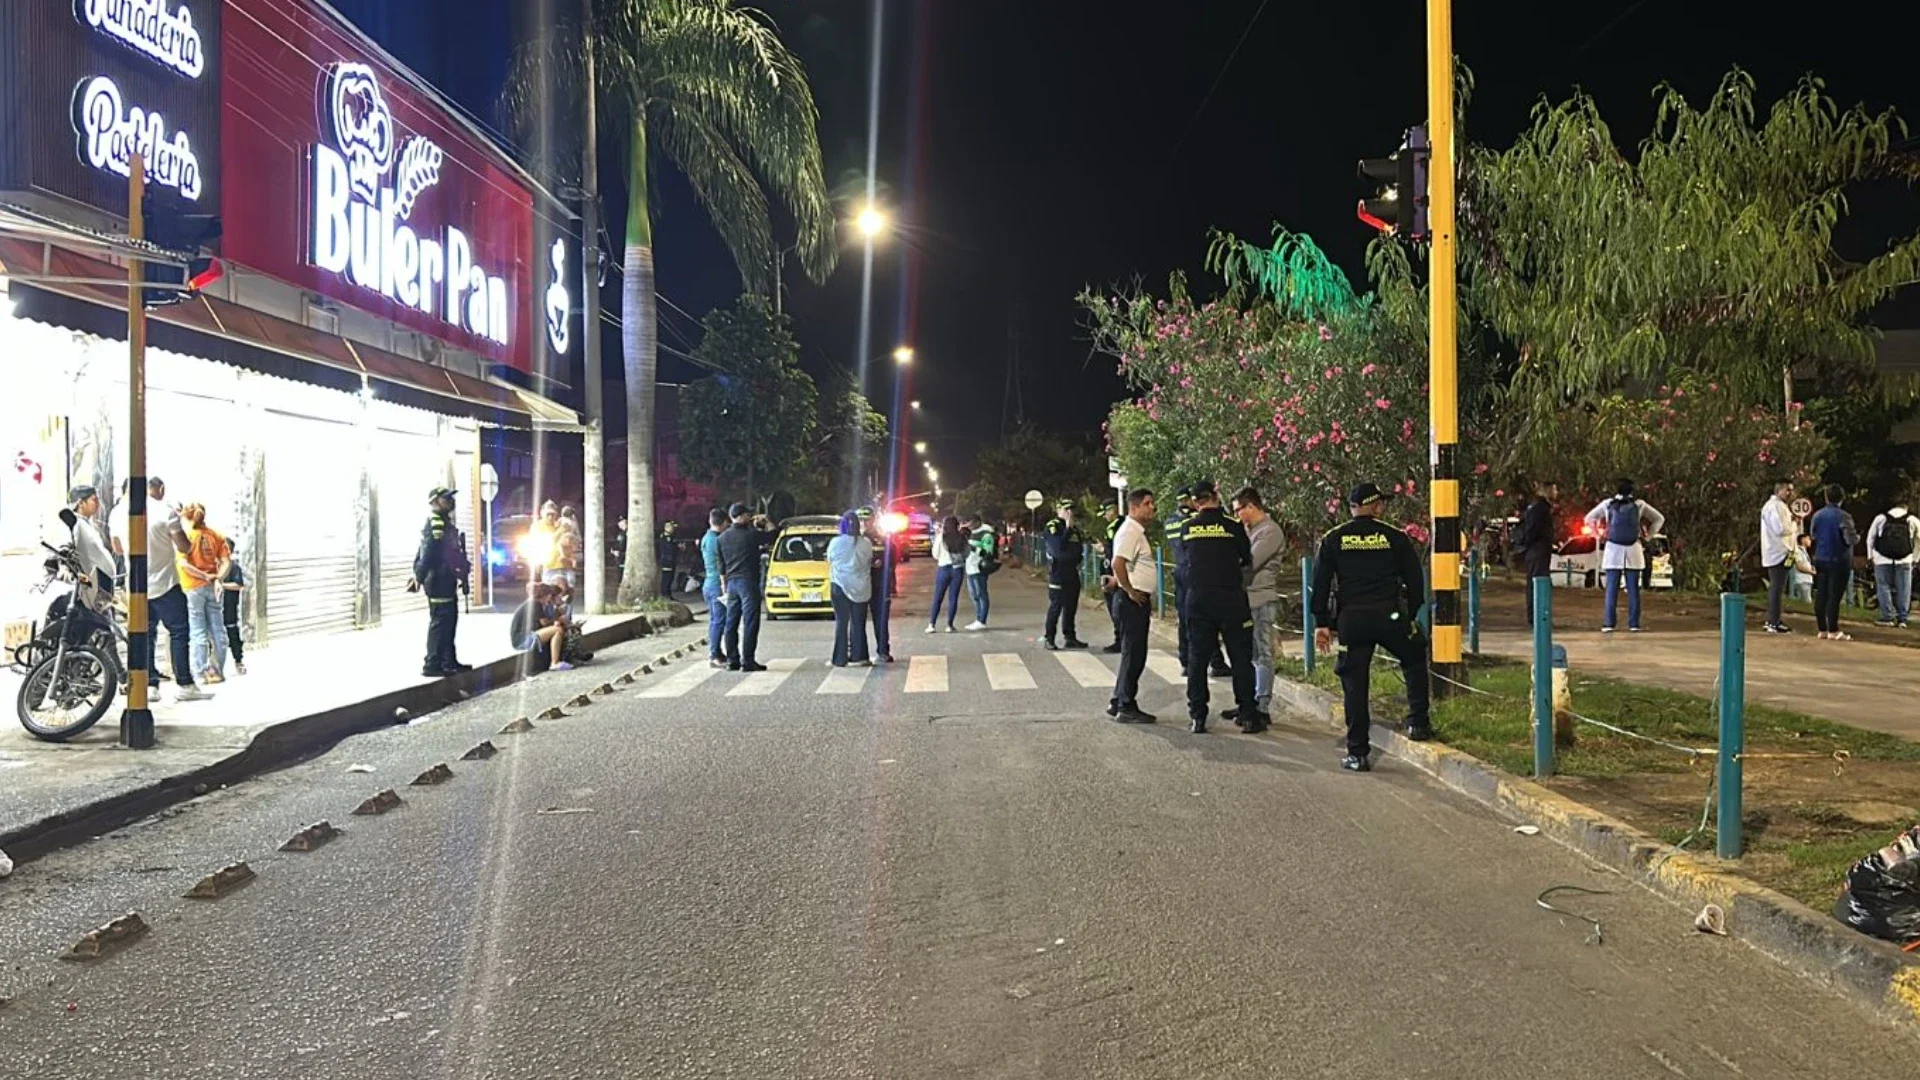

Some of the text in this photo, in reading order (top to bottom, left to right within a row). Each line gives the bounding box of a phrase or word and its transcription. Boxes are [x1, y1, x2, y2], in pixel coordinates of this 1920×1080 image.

[447, 225, 507, 345] Pan
[1794, 501, 1810, 513] 30
[1340, 532, 1388, 545] POLICÍA
